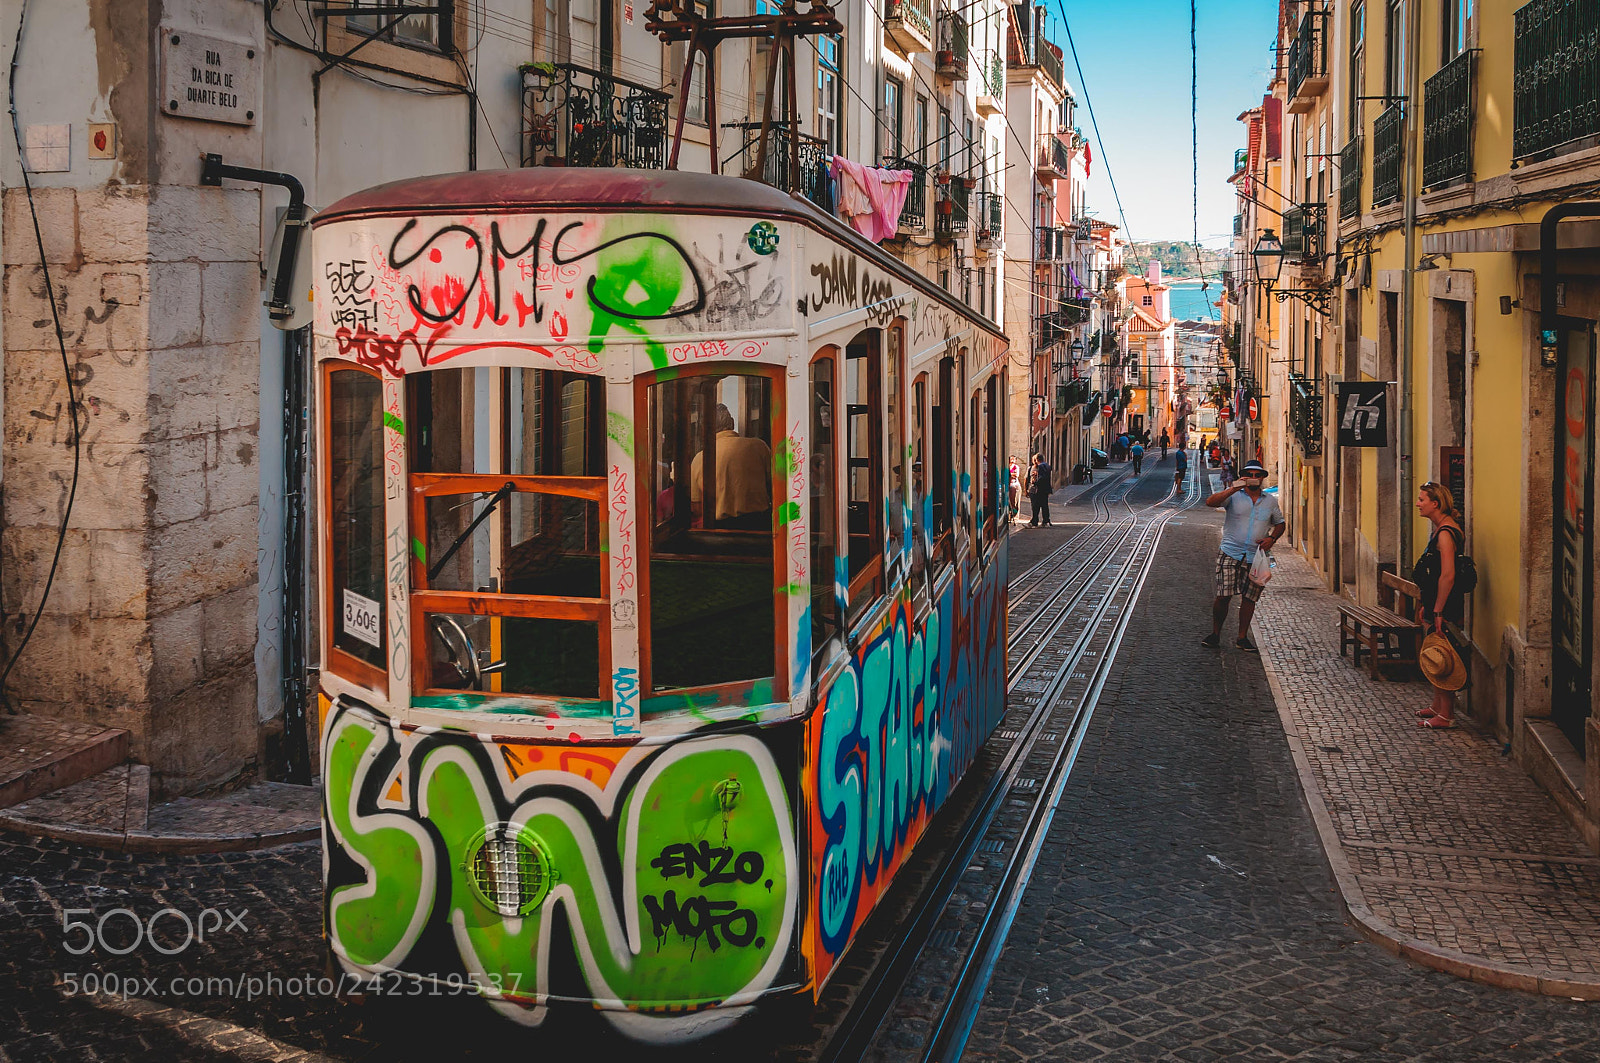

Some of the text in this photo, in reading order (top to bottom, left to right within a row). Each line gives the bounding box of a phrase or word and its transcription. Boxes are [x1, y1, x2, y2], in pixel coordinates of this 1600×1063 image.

[206, 50, 220, 66] RUA
[192, 67, 233, 88] DA BICA DE
[188, 87, 237, 108] DUARTE BELO
[346, 603, 377, 633] 3,60€
